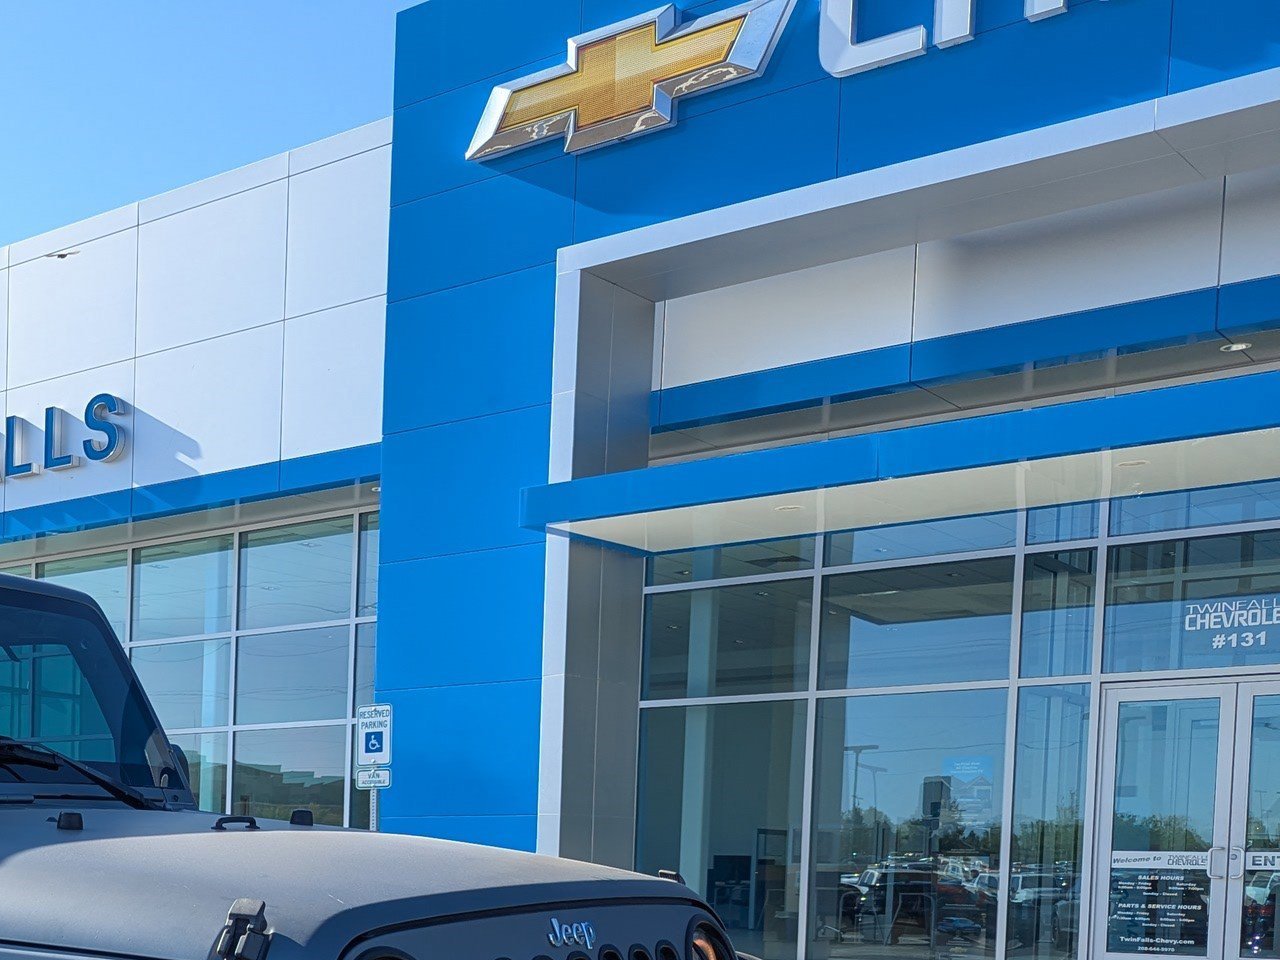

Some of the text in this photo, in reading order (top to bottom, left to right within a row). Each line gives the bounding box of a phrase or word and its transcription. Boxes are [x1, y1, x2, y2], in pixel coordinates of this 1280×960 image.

[1212, 631, 1266, 649] #131
[359, 709, 390, 719] RESERVED
[361, 720, 388, 729] PARKING
[1113, 856, 1150, 864] Welcome
[1252, 855, 1280, 866] EN
[547, 917, 597, 949] Jeep
